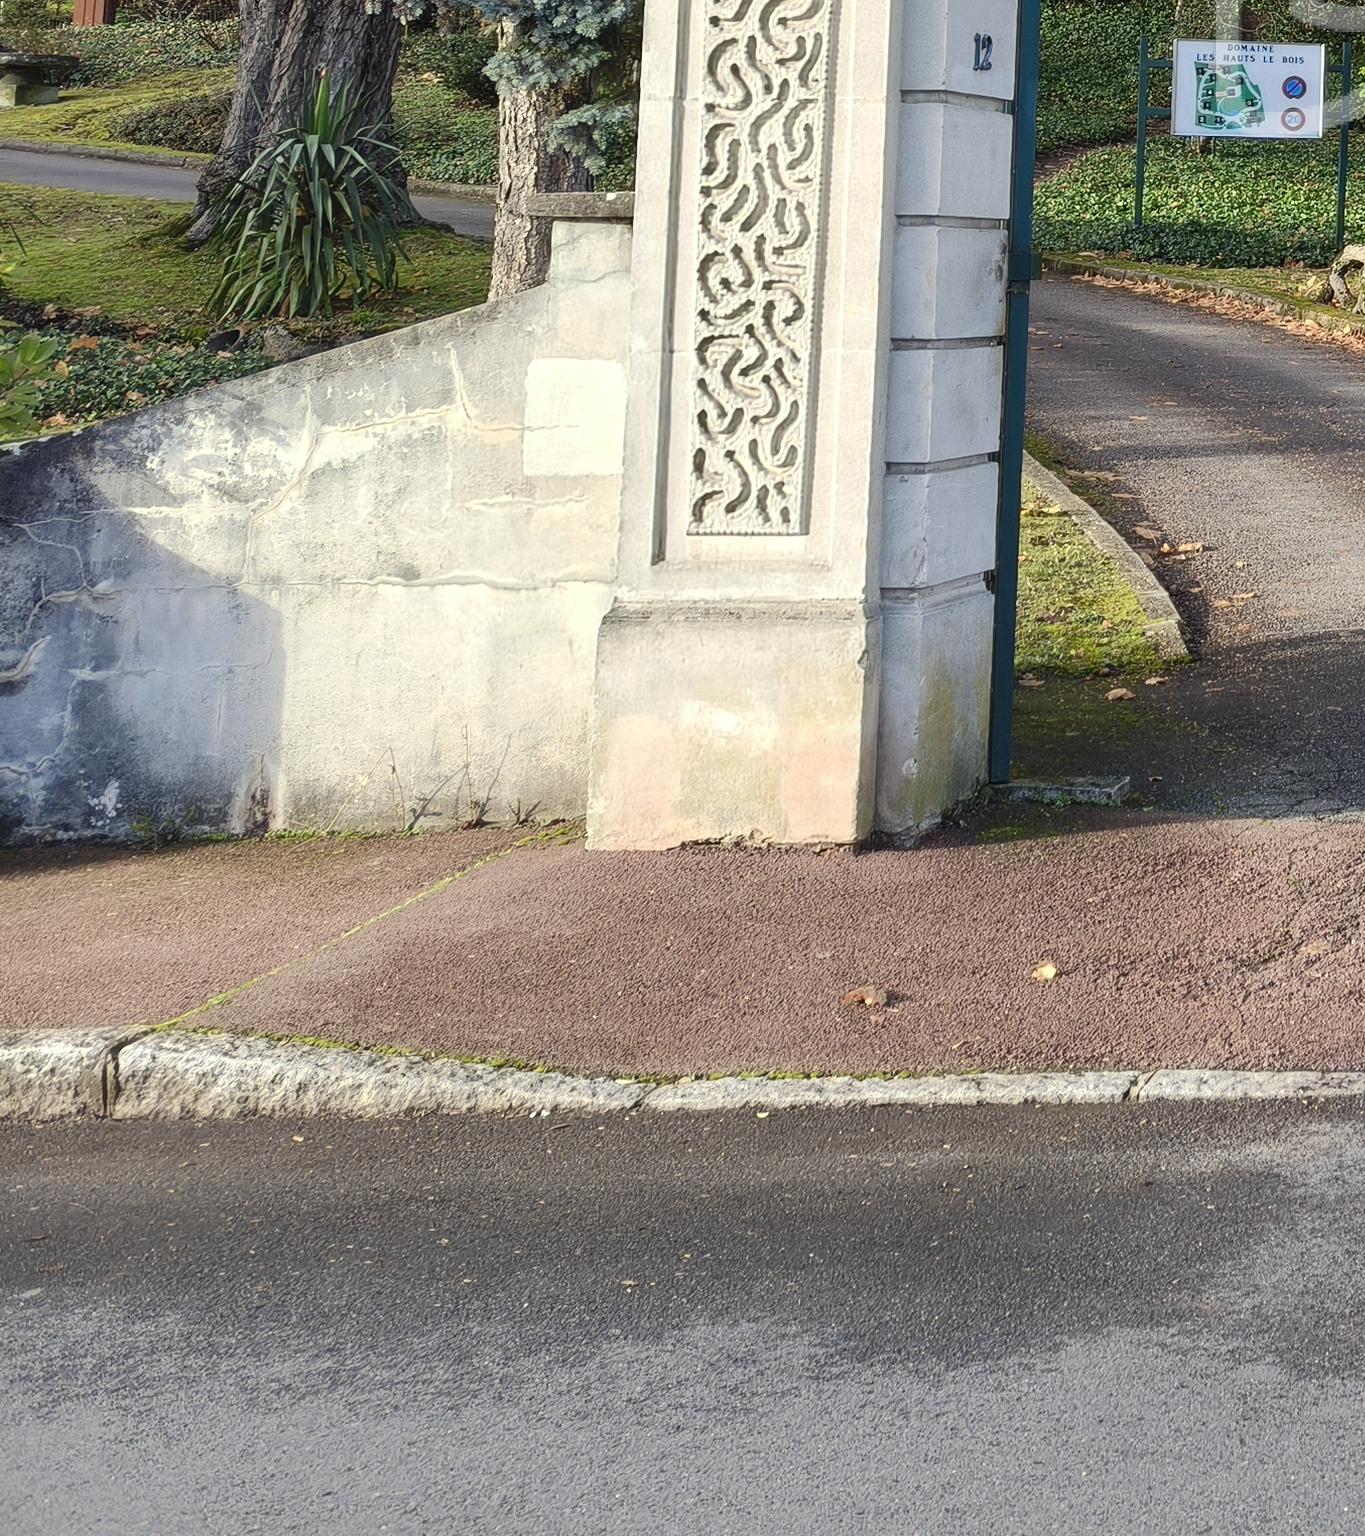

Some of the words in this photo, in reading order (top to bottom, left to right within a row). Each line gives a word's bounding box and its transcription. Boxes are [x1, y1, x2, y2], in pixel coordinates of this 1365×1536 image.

[973, 32, 993, 71] 12
[1227, 44, 1275, 53] DOMAINE
[1196, 53, 1215, 62] LES
[1223, 54, 1256, 63] HAUTS
[1263, 56, 1275, 64] LE
[1282, 56, 1305, 65] BOIS
[1287, 114, 1300, 124] 20
